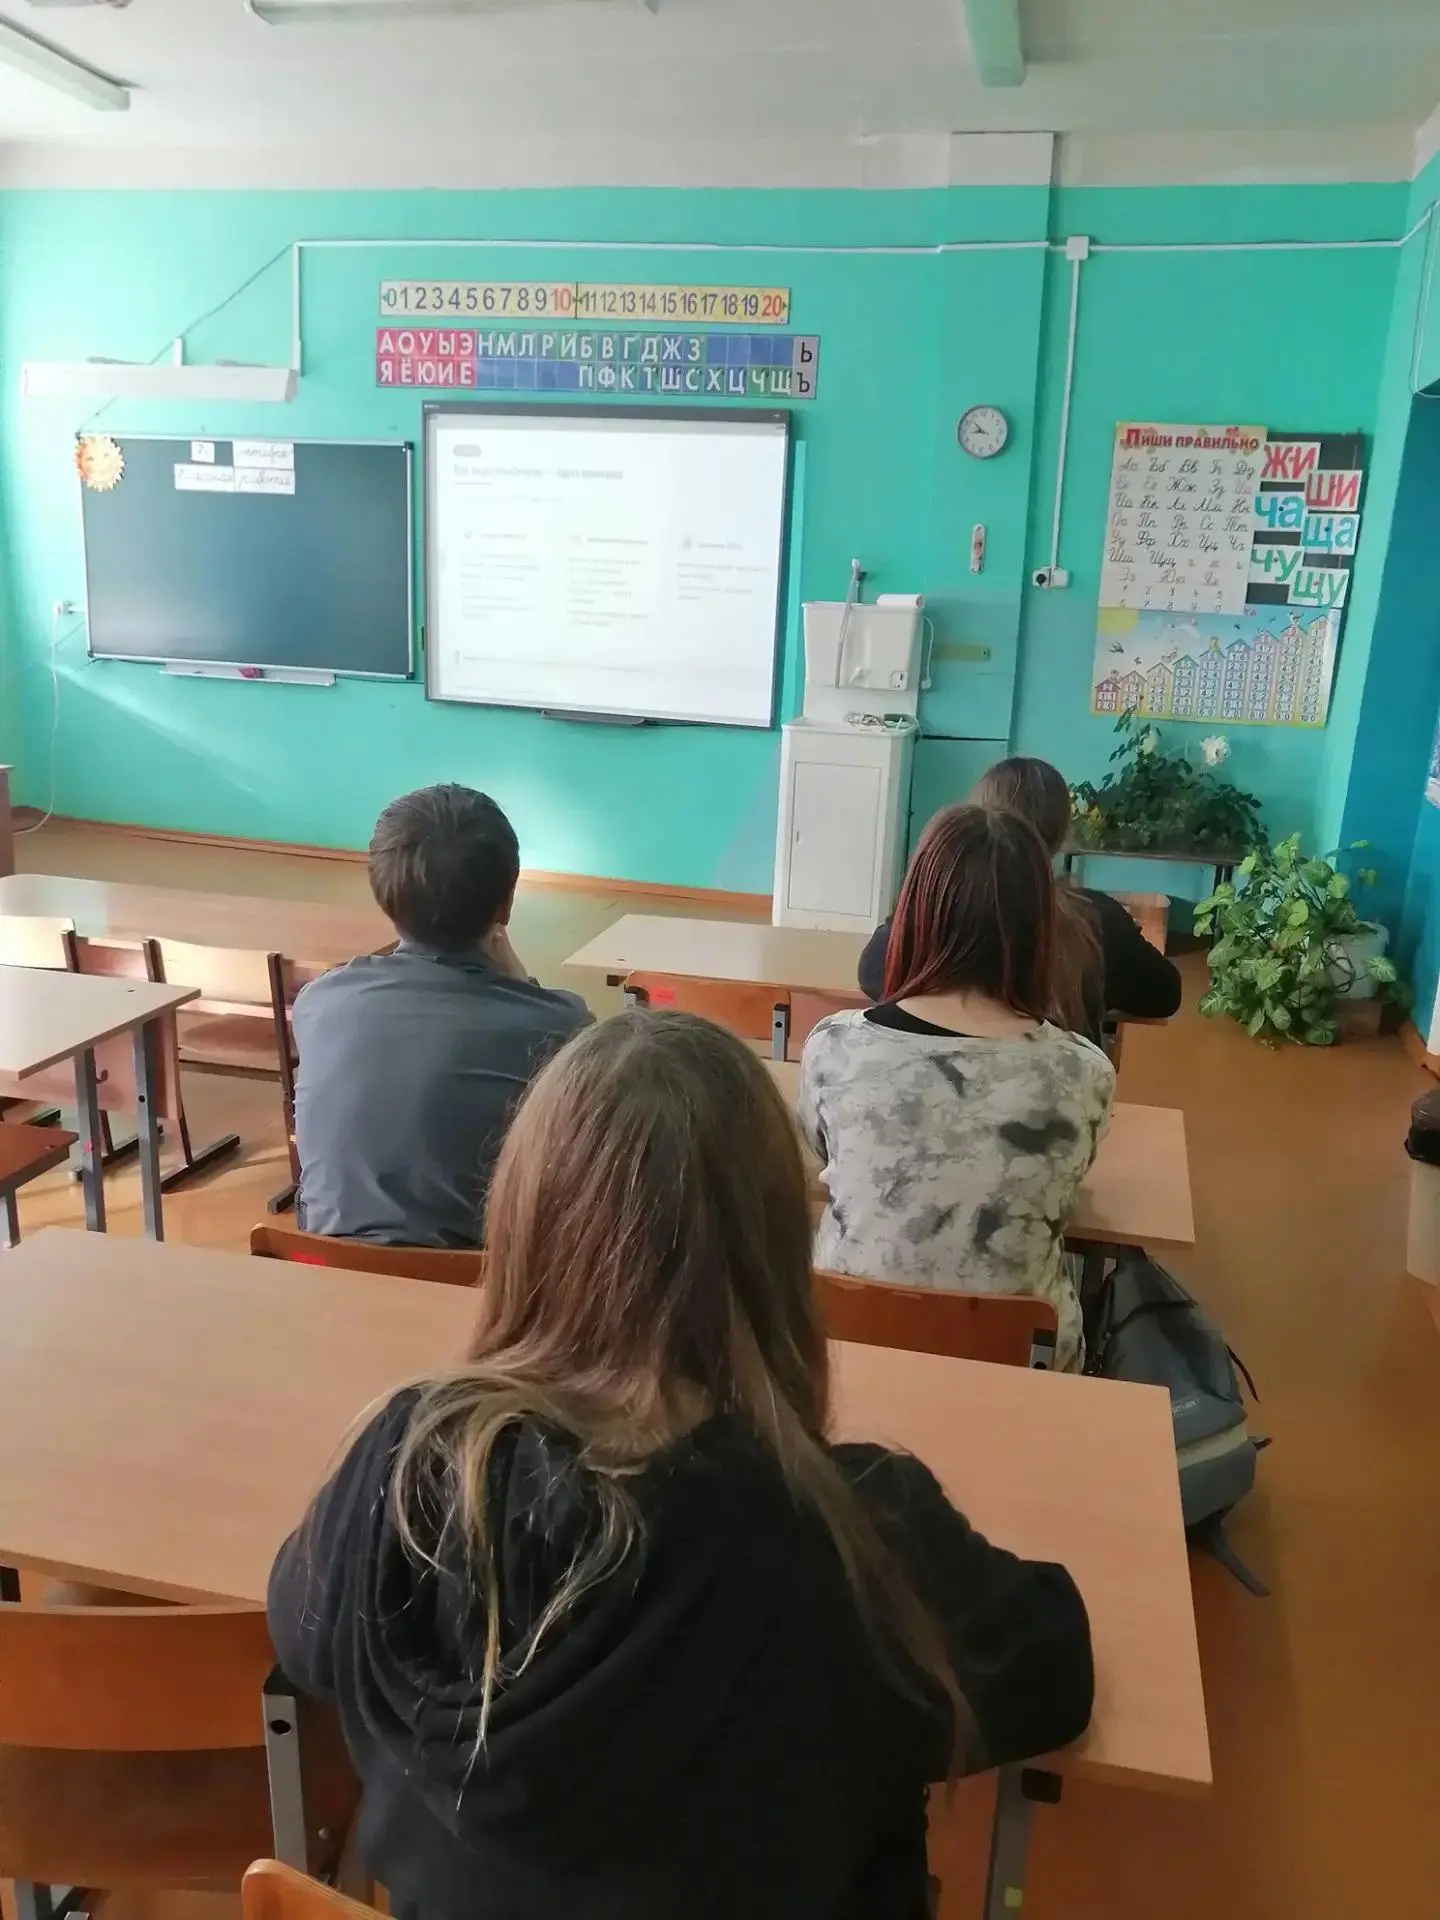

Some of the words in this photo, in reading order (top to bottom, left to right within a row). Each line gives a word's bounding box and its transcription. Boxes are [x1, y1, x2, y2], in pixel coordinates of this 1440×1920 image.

[388, 288, 396, 308] 0
[401, 288, 408, 308] 1
[416, 288, 426, 309] 2
[432, 288, 444, 309] 3
[449, 288, 460, 310] 4
[466, 288, 478, 310] 5
[483, 288, 495, 310] 6
[501, 288, 511, 310] 7
[518, 288, 529, 310] 8
[535, 288, 546, 310] 9
[552, 288, 571, 310] 10
[583, 291, 596, 312] 11
[601, 291, 616, 312] 12
[620, 292, 636, 313] 13
[640, 292, 656, 313] 14
[661, 292, 676, 314] 15
[681, 293, 697, 315] 16
[701, 293, 718, 315] 17
[722, 294, 737, 315] 18
[742, 294, 758, 316] 19
[762, 295, 782, 316] 20
